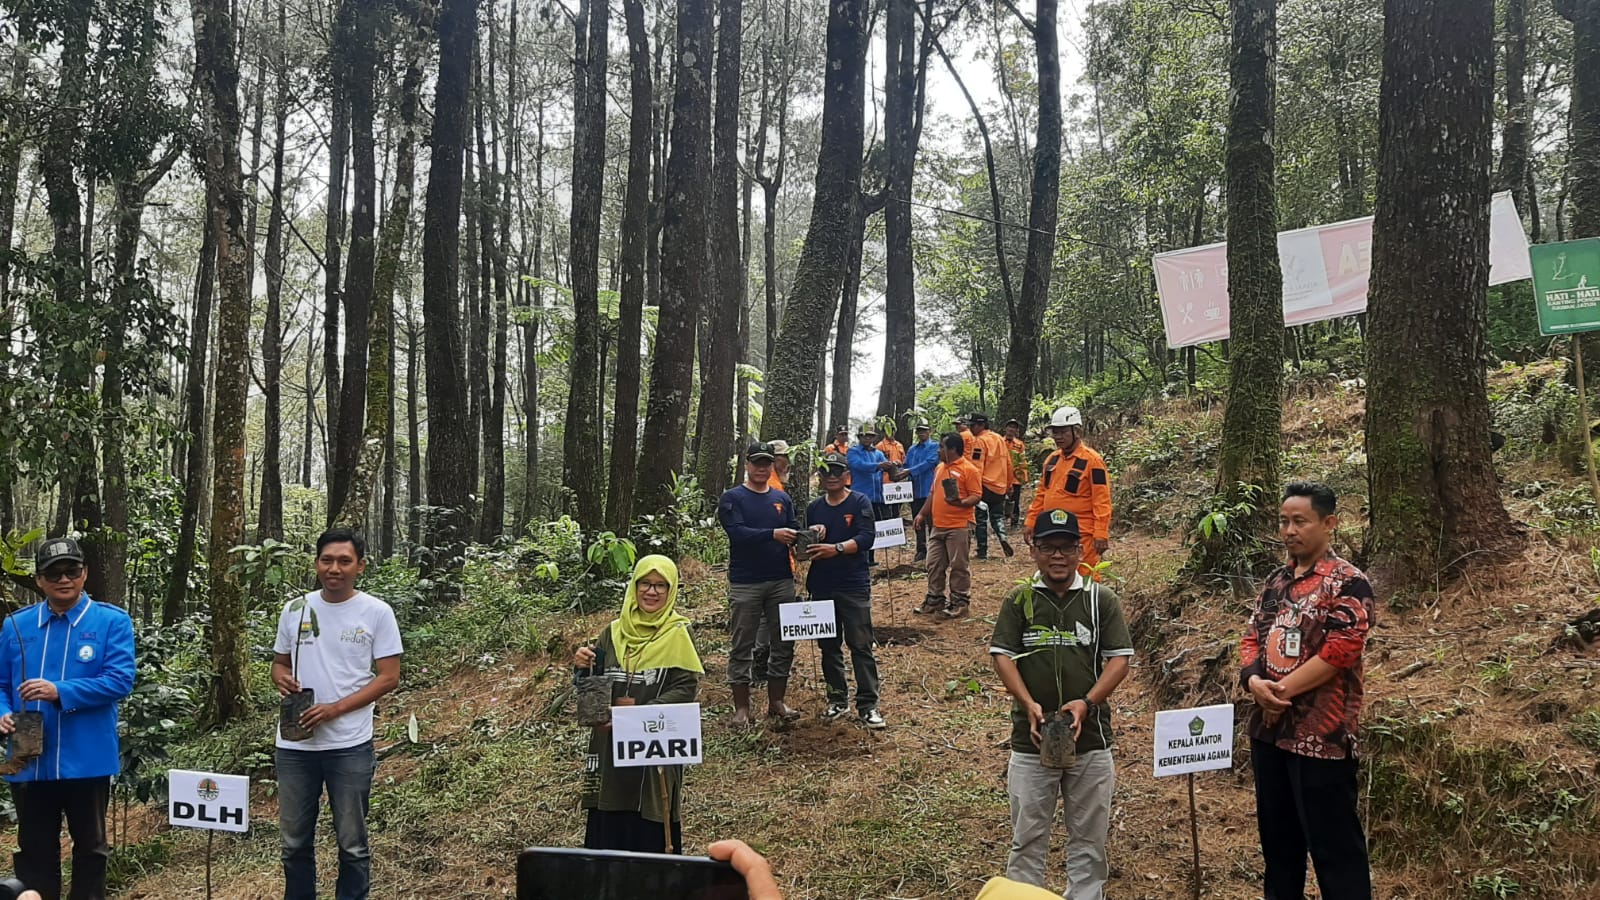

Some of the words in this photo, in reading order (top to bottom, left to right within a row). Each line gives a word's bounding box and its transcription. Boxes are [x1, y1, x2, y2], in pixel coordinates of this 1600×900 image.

[1545, 292, 1569, 302] HATI
[1577, 290, 1600, 299] HATI
[885, 493, 902, 501] KEPALA
[783, 622, 835, 637] PERHUTANI
[617, 738, 698, 760] IPARI
[1168, 737, 1194, 750] KEPALA
[1195, 734, 1222, 746] KANTOR
[1158, 752, 1206, 768] KEMENTERIAN
[1207, 749, 1230, 761] AGAMA
[173, 801, 243, 825] DLH
